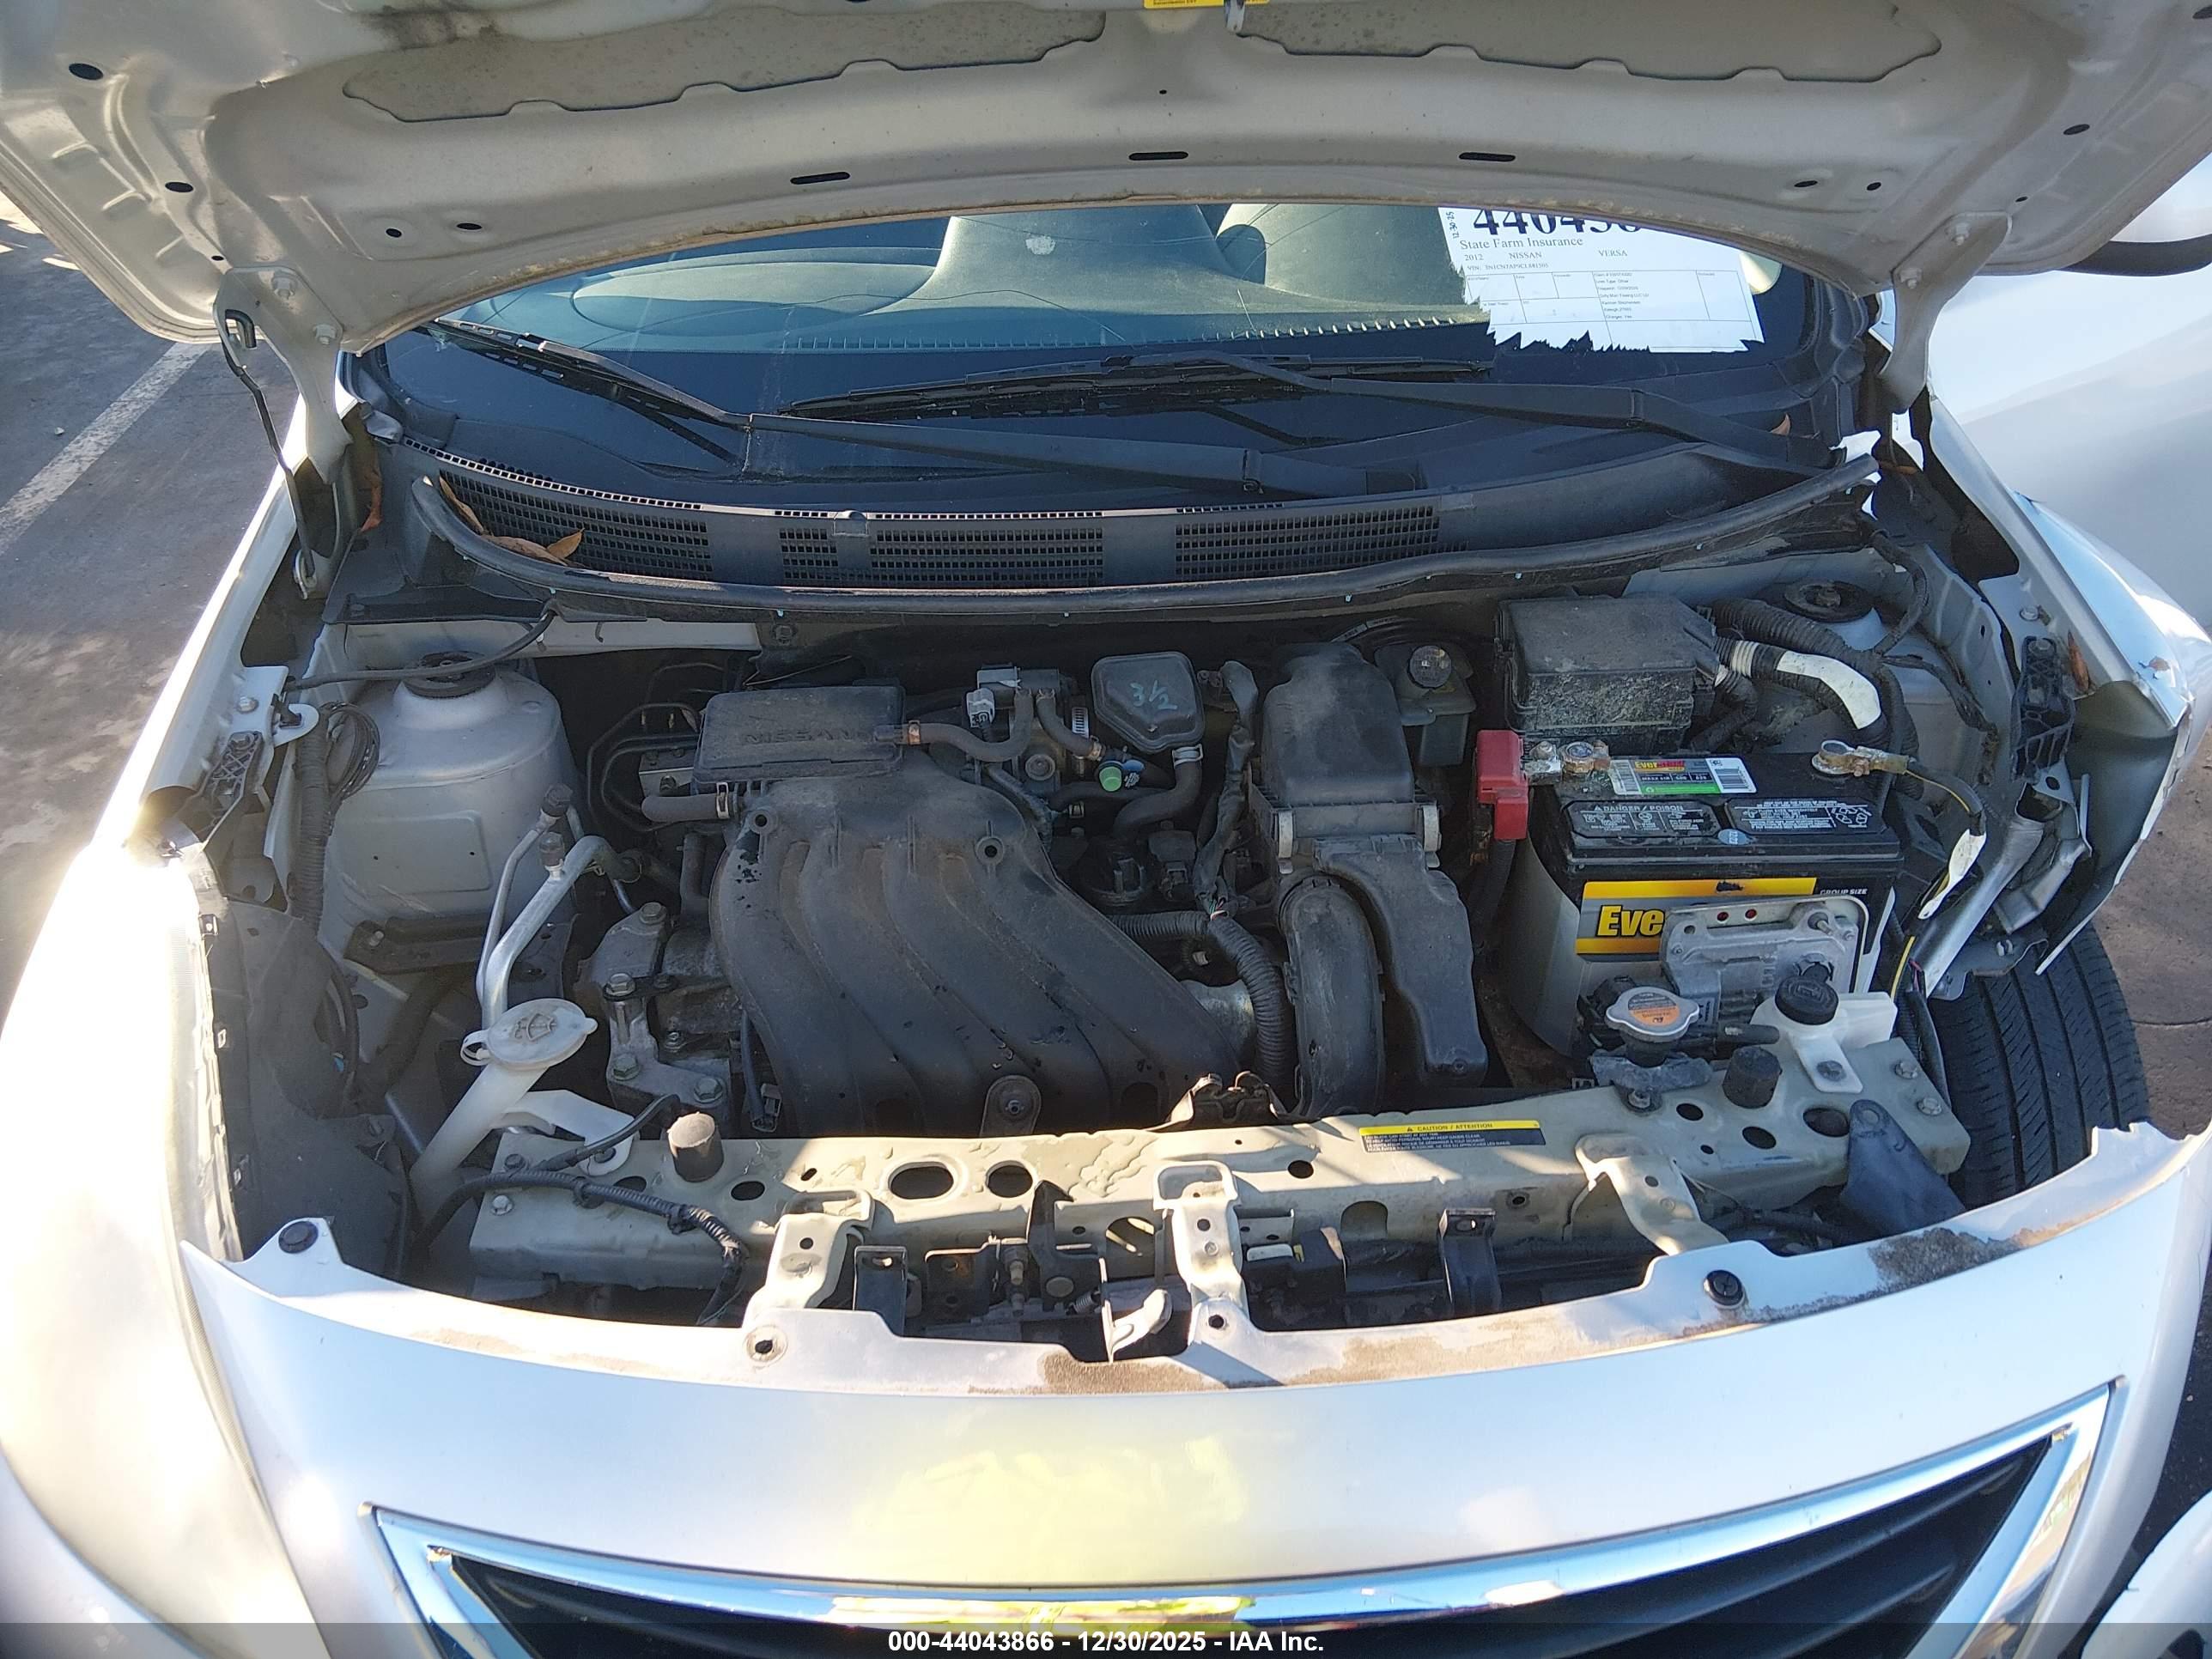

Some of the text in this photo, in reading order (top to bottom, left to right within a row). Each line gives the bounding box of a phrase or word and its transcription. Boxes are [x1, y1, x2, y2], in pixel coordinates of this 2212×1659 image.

[1460, 237, 1584, 250] State Farm Insurance
[1509, 252, 1542, 260] NISSAN
[1598, 249, 1628, 258] VERSA
